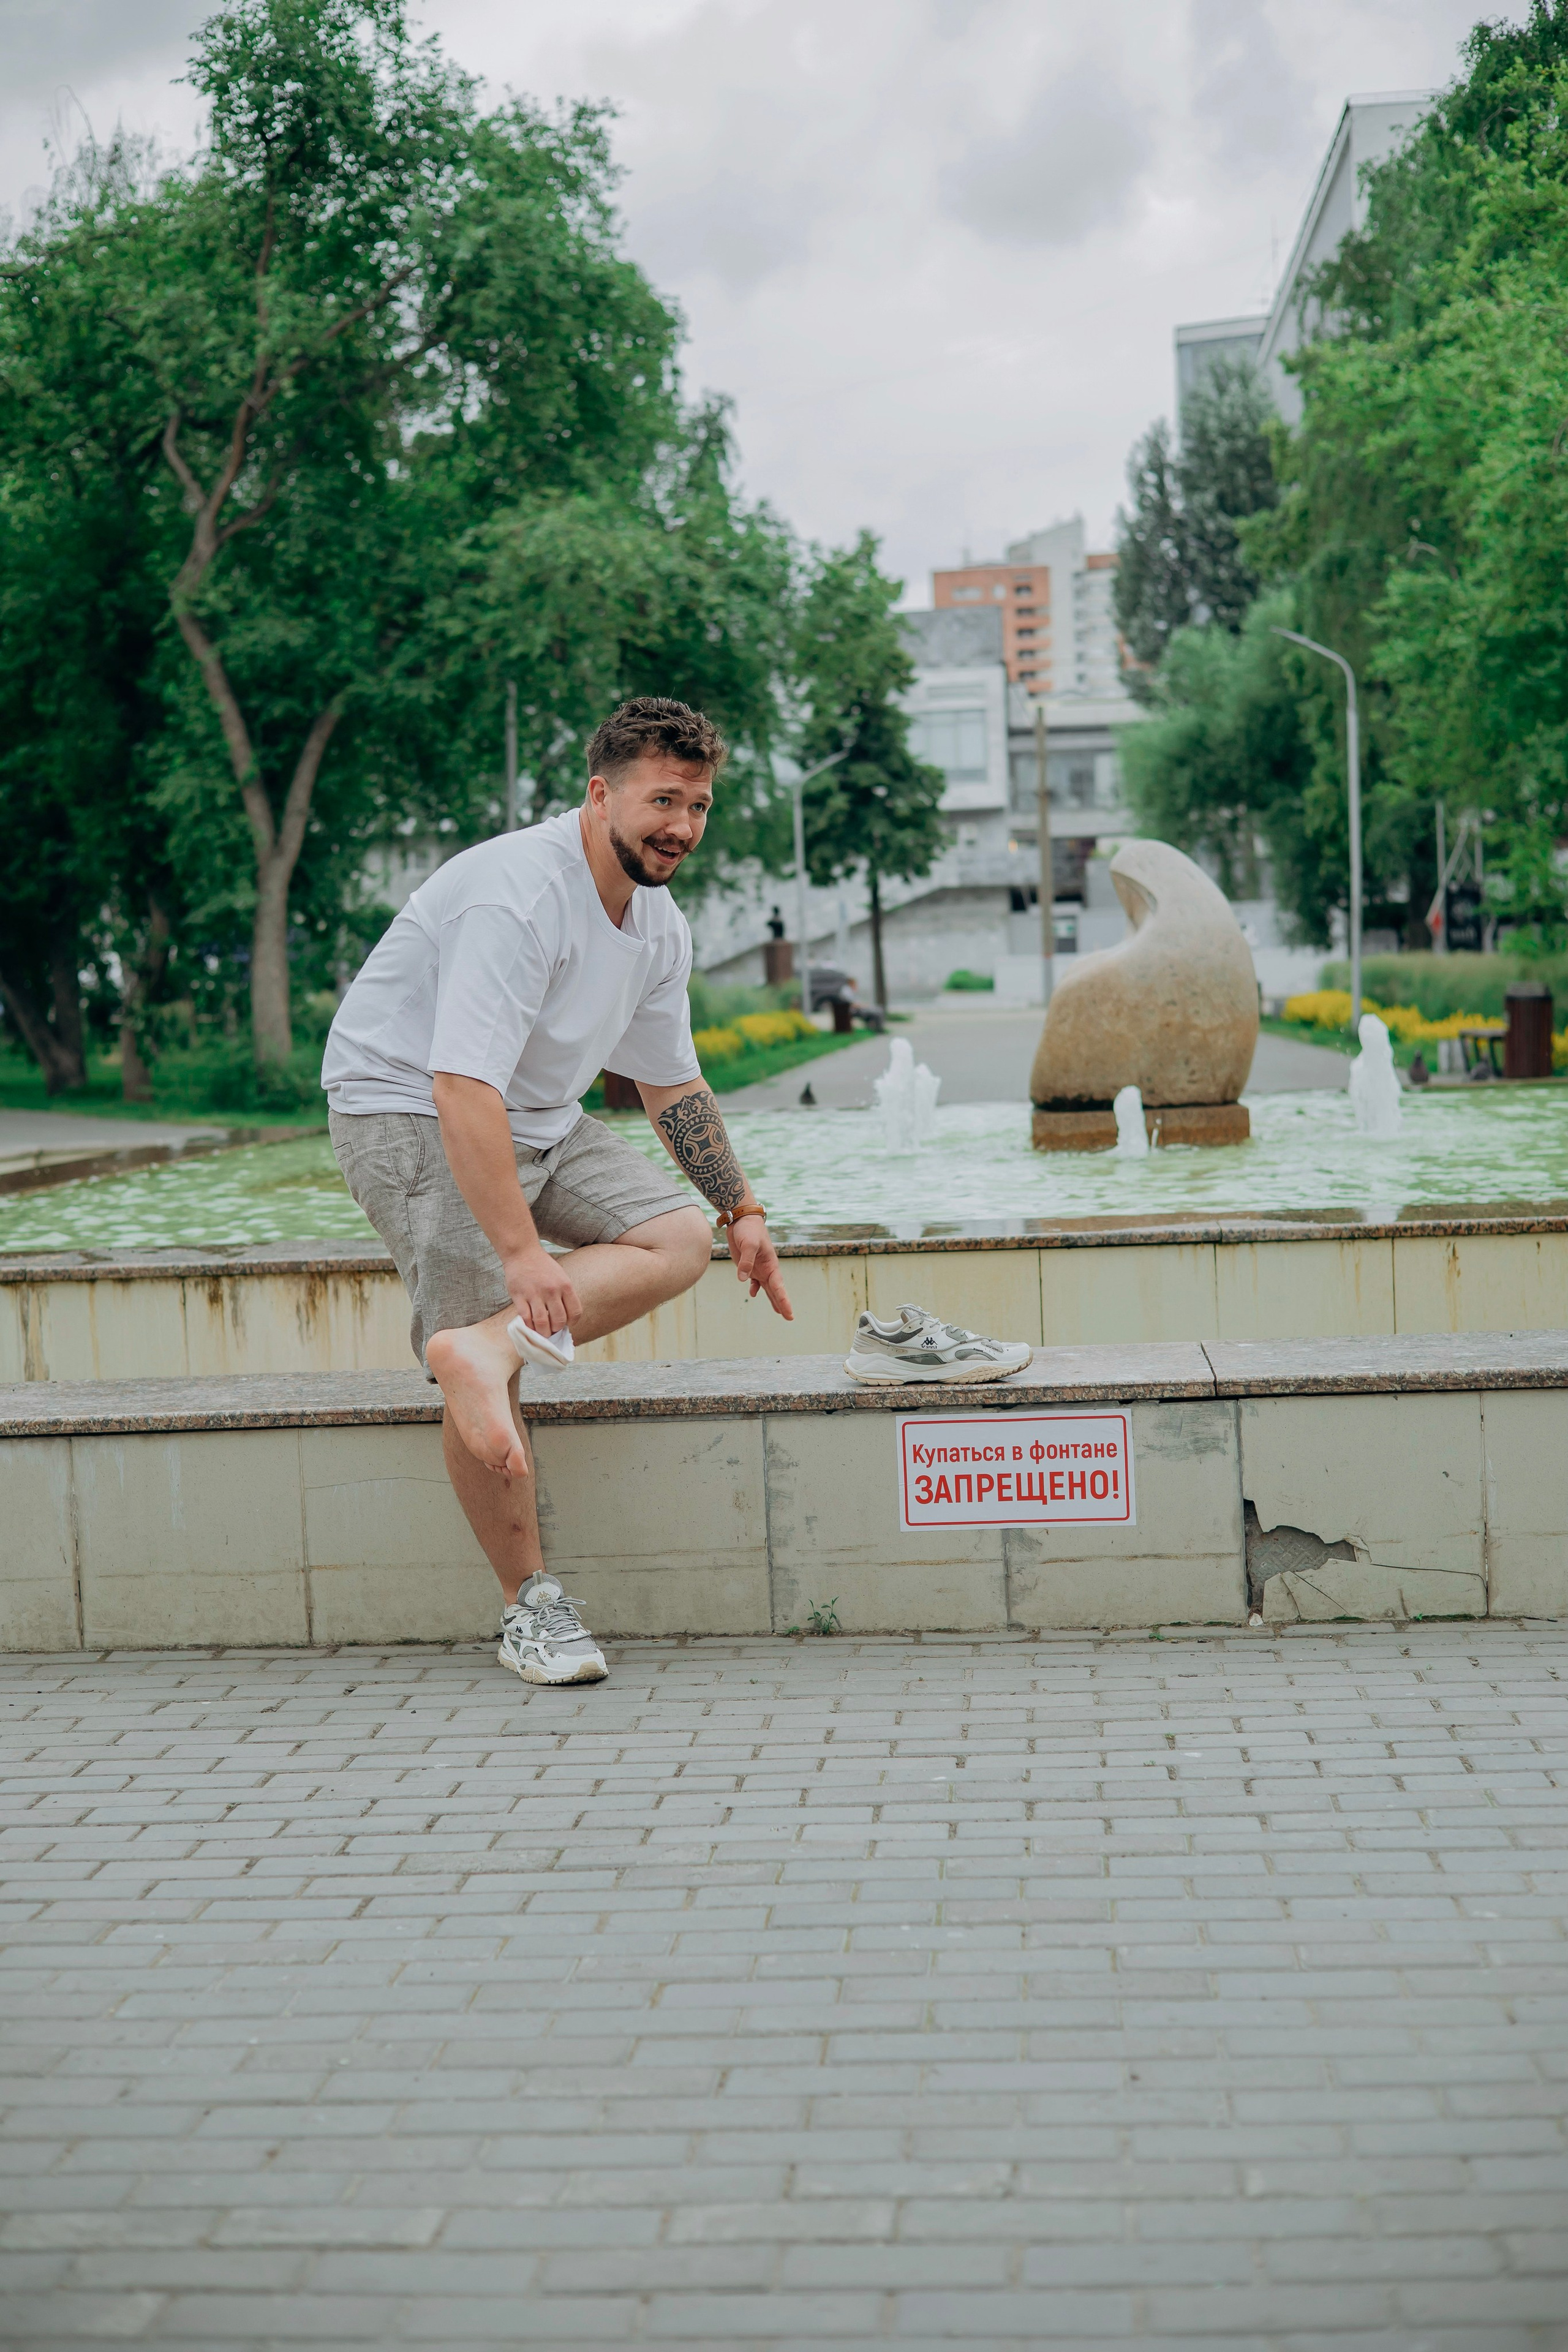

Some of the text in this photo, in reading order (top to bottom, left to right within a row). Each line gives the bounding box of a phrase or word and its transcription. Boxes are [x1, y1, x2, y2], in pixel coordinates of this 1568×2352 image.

[913, 1439, 1117, 1468] Купаться в фонтане
[914, 1469, 1119, 1506] ЗАПРЕЩЕНО!
